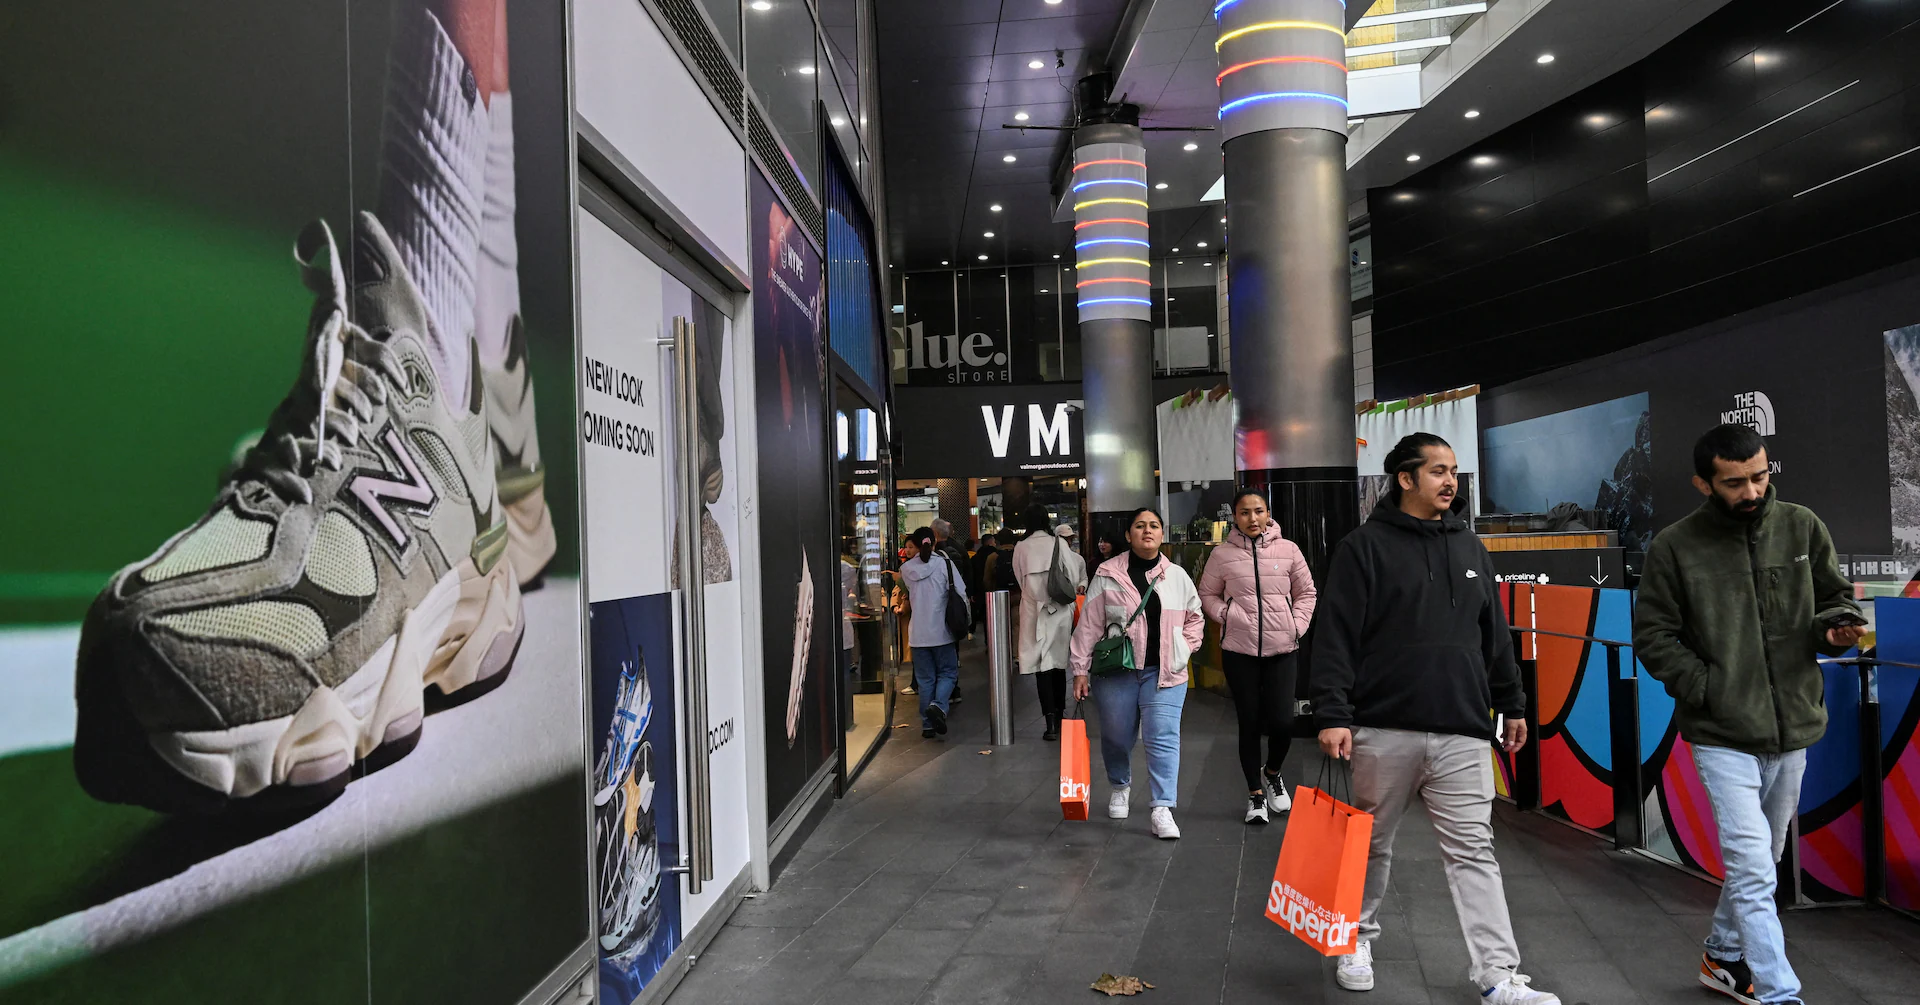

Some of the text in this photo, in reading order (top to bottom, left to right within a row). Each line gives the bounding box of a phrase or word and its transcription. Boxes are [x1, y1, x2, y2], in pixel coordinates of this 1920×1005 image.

[585, 356, 645, 408] NEW LOOK
[948, 370, 1008, 384] STORE
[1734, 392, 1755, 408] THE
[1721, 407, 1755, 425] NORTH
[626, 423, 655, 458] SOON
[1505, 573, 1536, 583] priceline
[1060, 779, 1090, 804] dry
